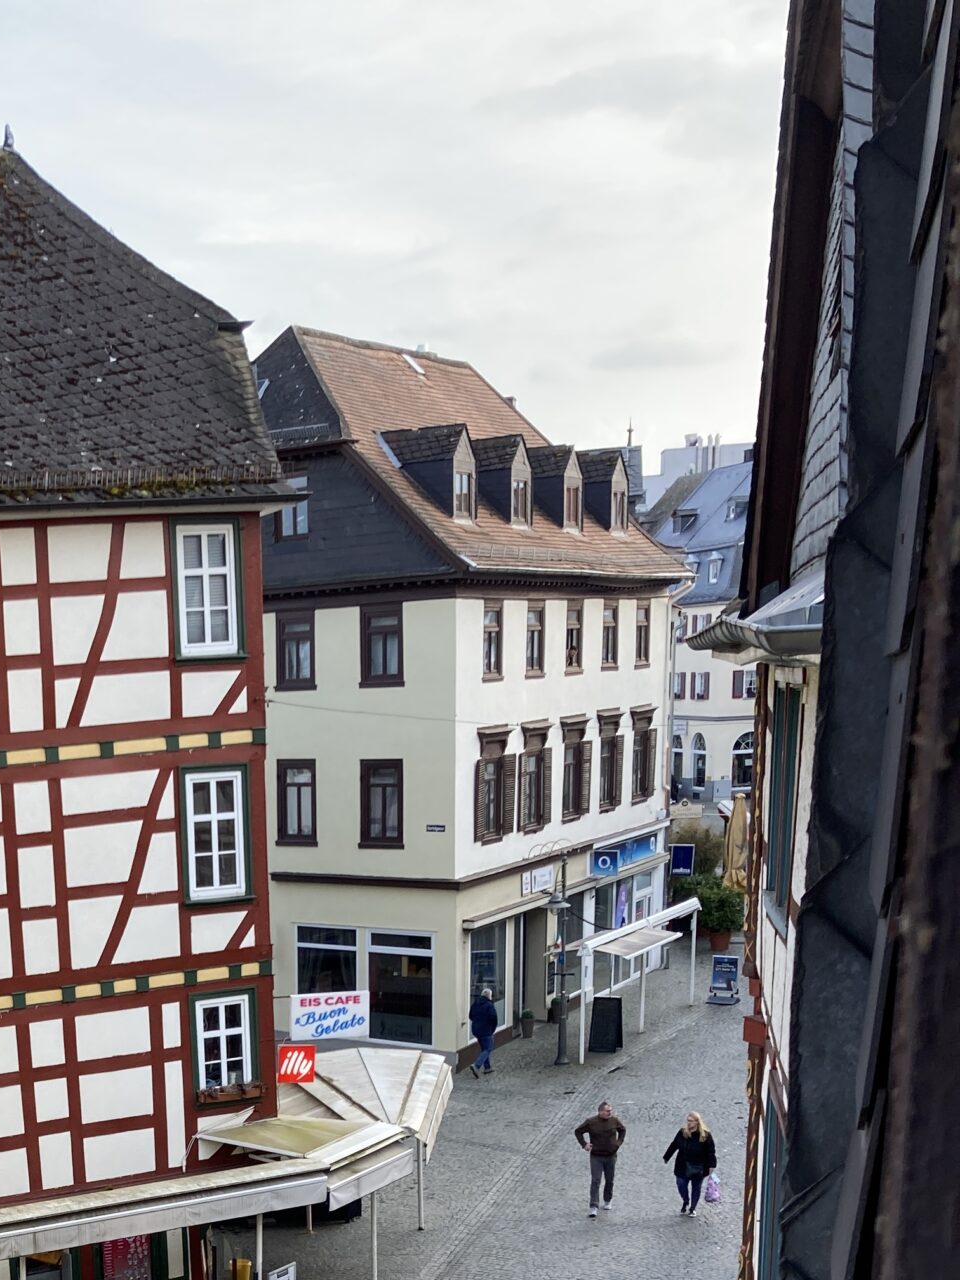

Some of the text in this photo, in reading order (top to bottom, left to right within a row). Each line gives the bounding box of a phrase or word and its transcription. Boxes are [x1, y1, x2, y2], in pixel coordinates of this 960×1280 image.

[598, 856, 614, 871] O2
[300, 995, 361, 1008] EIS CAFE
[299, 1006, 349, 1027] Buon
[311, 1013, 367, 1038] Gelato
[280, 1050, 313, 1080] illy
